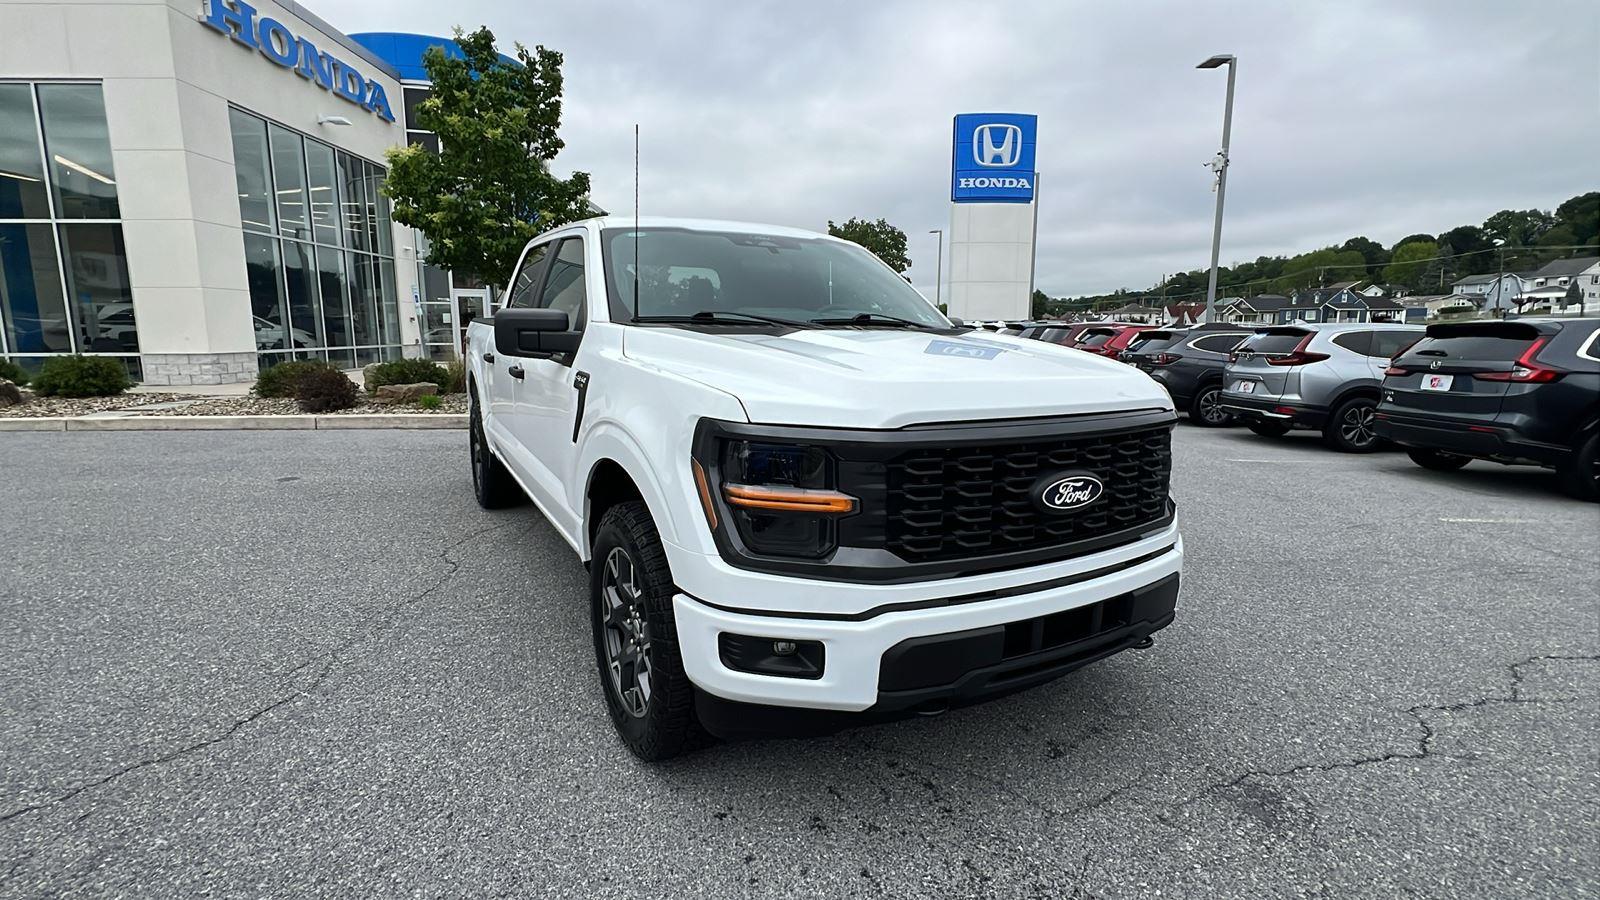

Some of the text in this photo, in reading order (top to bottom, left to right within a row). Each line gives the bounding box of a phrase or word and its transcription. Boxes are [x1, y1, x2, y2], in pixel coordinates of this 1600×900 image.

[199, 0, 396, 123] HONDA
[958, 177, 1032, 189] HONDA
[1054, 481, 1093, 505] Ford
